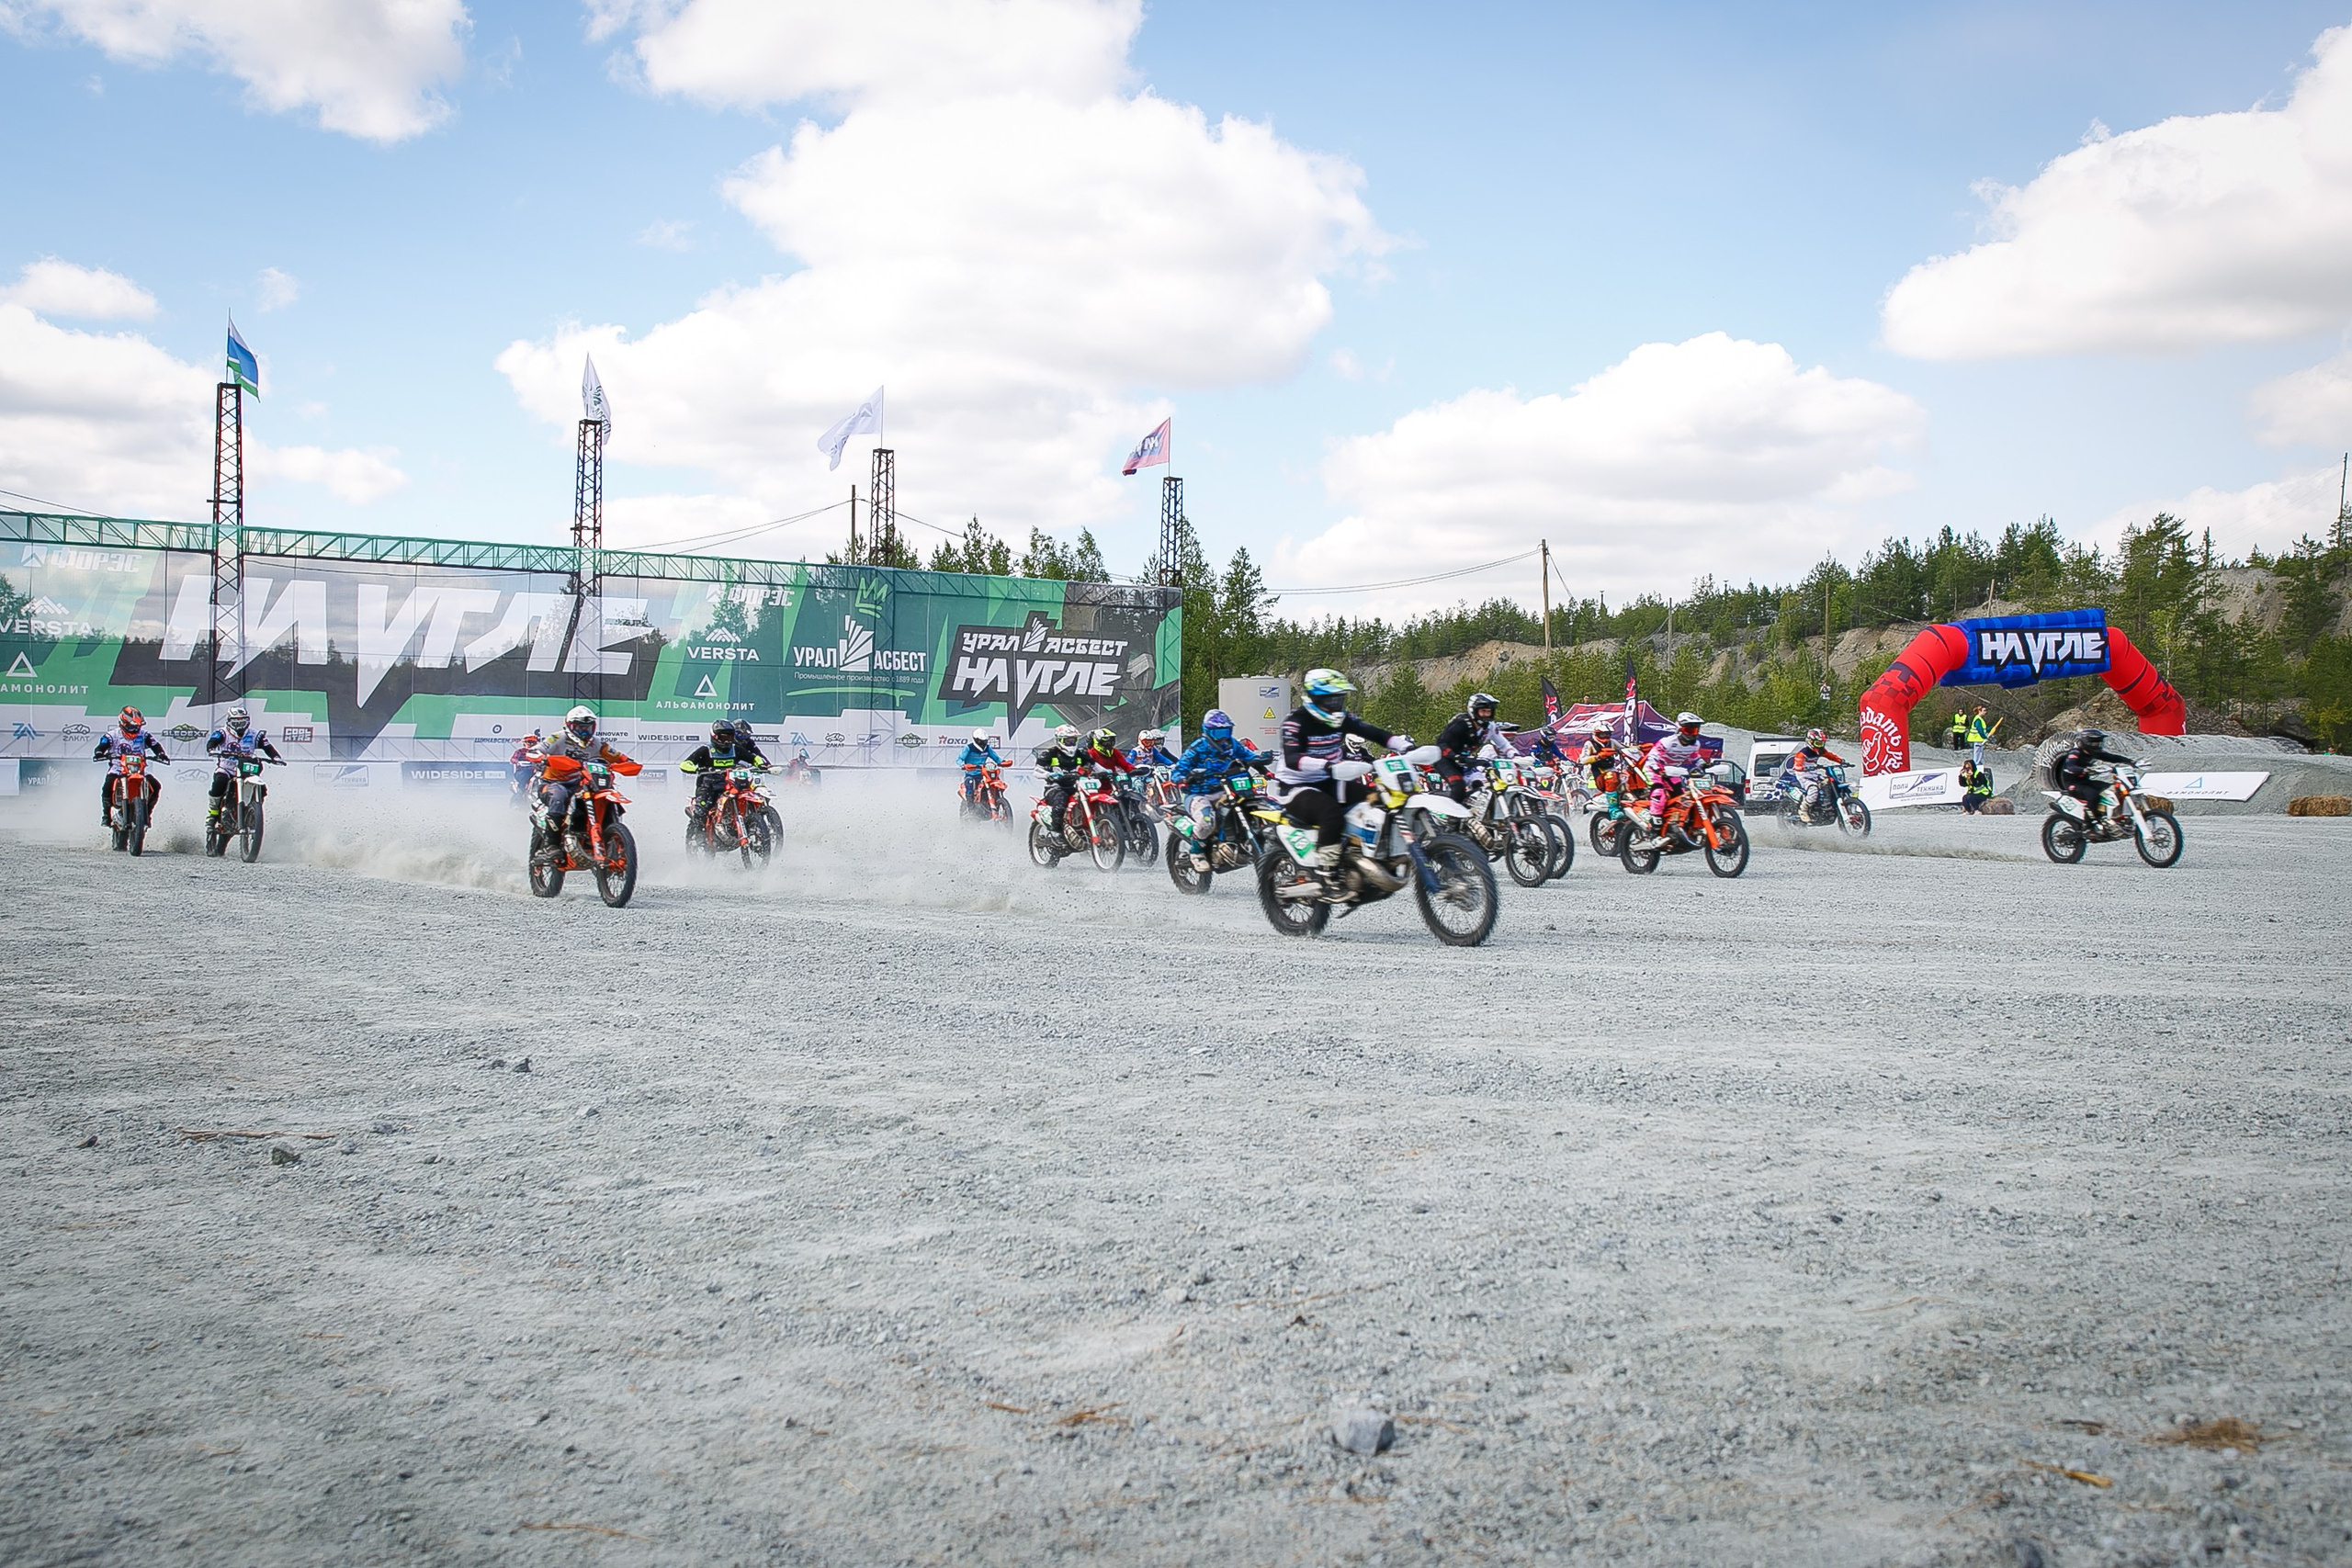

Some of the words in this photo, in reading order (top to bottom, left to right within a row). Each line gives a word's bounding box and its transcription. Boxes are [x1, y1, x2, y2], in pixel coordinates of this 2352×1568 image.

[51, 547, 142, 573] ФОРЭС
[728, 585, 795, 606] ФОРЭС
[0, 619, 95, 637] VERSTA
[687, 646, 760, 661] VERSTA
[962, 632, 1020, 654] УРАЛ
[1044, 637, 1128, 657] АСБЕСТ
[793, 646, 837, 668] УРАЛ
[874, 649, 926, 671] АСБЕСТ
[794, 671, 845, 681] Промышленное
[846, 674, 889, 682] производство
[656, 701, 755, 711] АЛЬФАМОНОЛИТ
[411, 771, 483, 779] WIDESIDE
